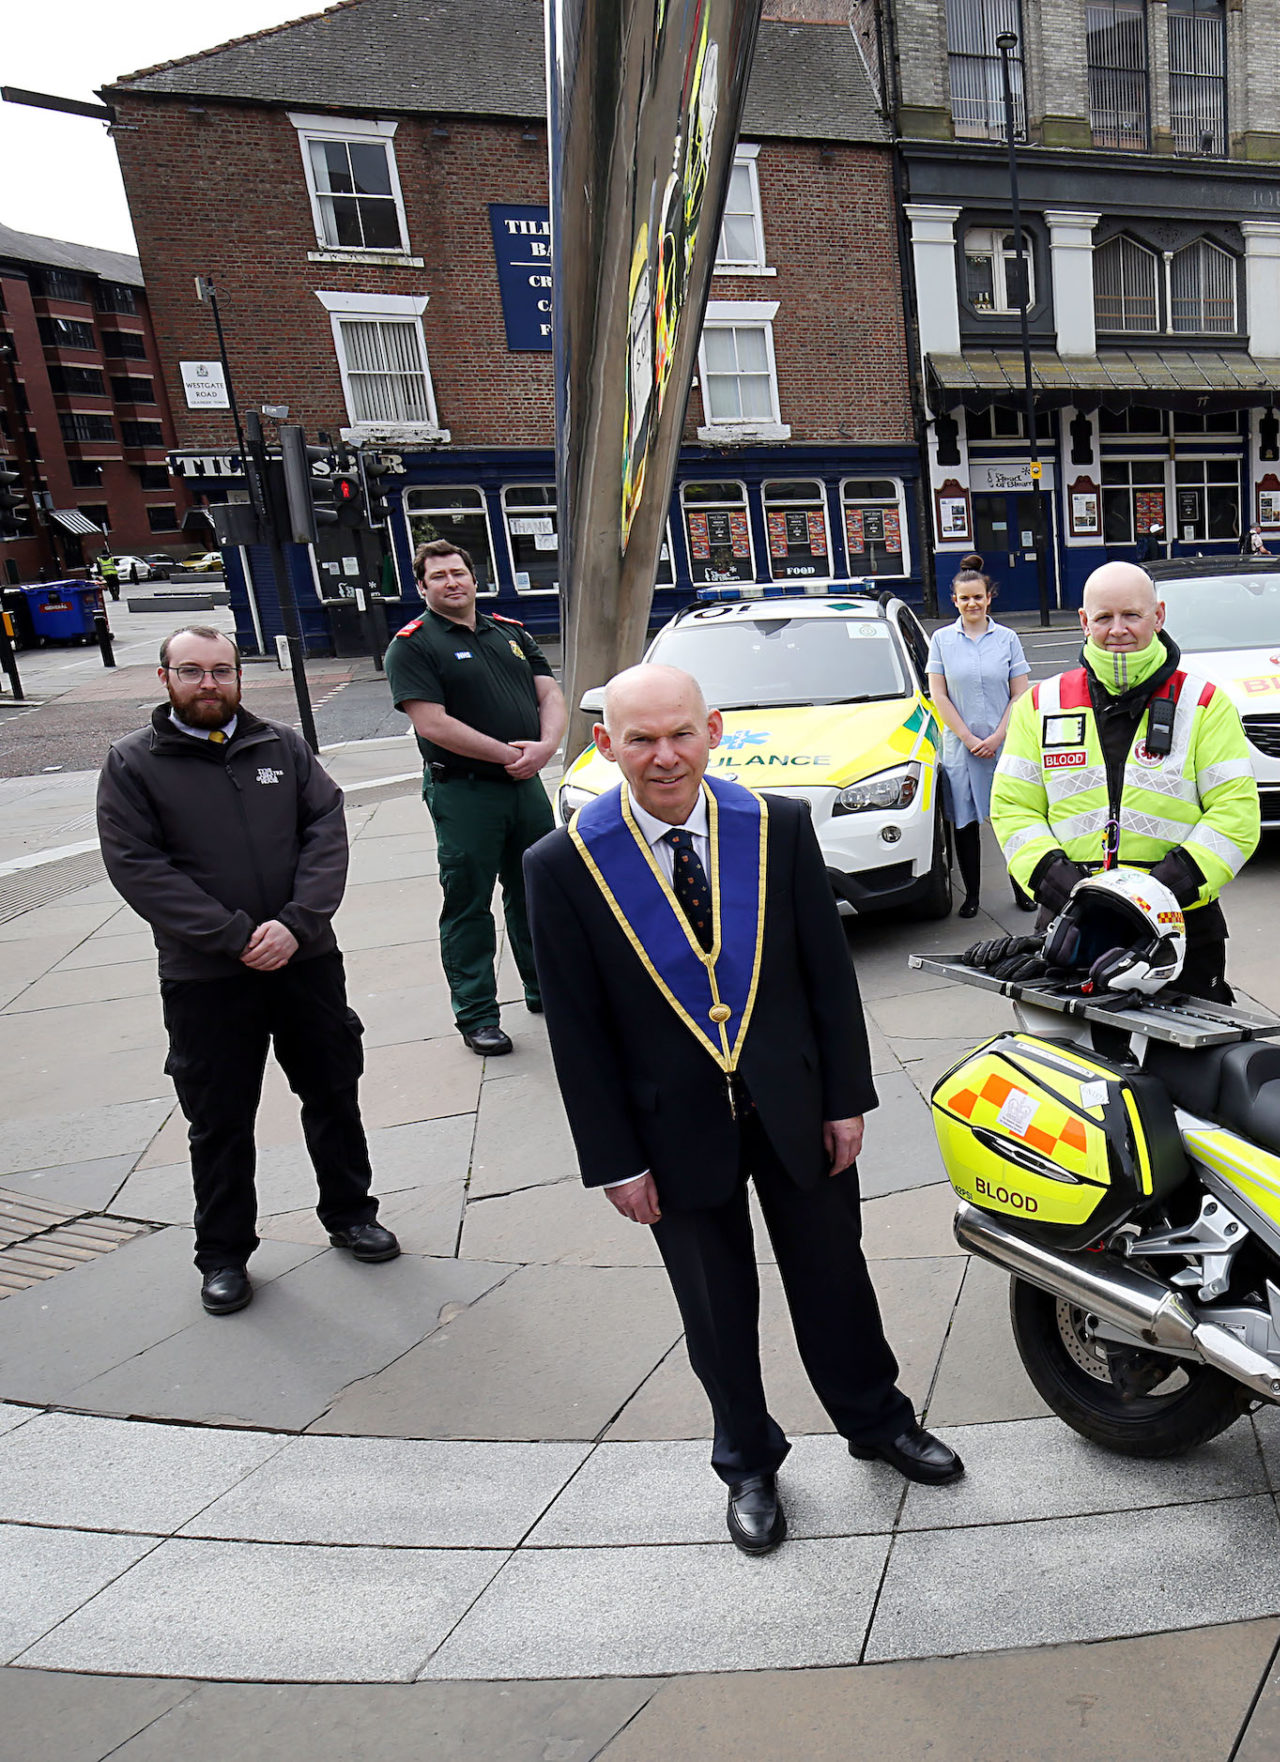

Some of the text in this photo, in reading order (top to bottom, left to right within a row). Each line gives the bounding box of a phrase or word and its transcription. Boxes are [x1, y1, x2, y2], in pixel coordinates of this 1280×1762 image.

[511, 520, 551, 533] THANK
[786, 566, 815, 576] FOOD
[1045, 753, 1084, 766] BLOOD
[975, 1177, 1038, 1213] BLOOD
